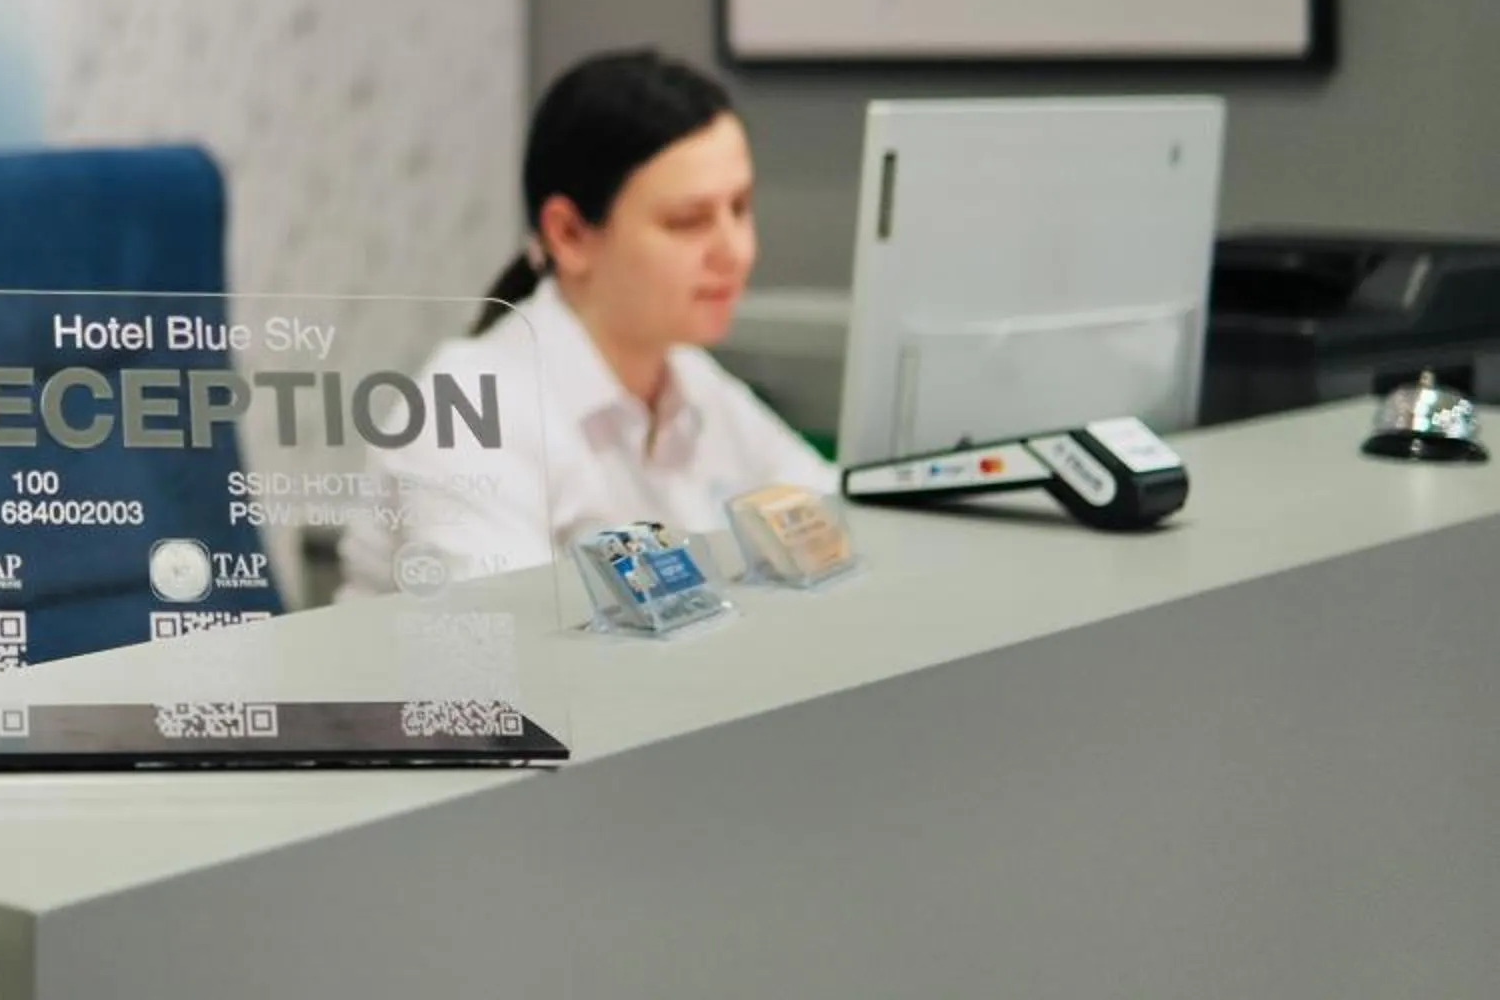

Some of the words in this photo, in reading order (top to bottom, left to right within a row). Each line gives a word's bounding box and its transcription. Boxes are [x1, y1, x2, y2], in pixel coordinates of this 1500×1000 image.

[52, 313, 154, 350] Hotel
[166, 315, 252, 351] Blue
[263, 316, 336, 360] Sky
[11, 470, 60, 496] 100
[302, 472, 391, 498] HOTEL
[1, 500, 145, 526] 684002003
[211, 552, 268, 579] TAP
